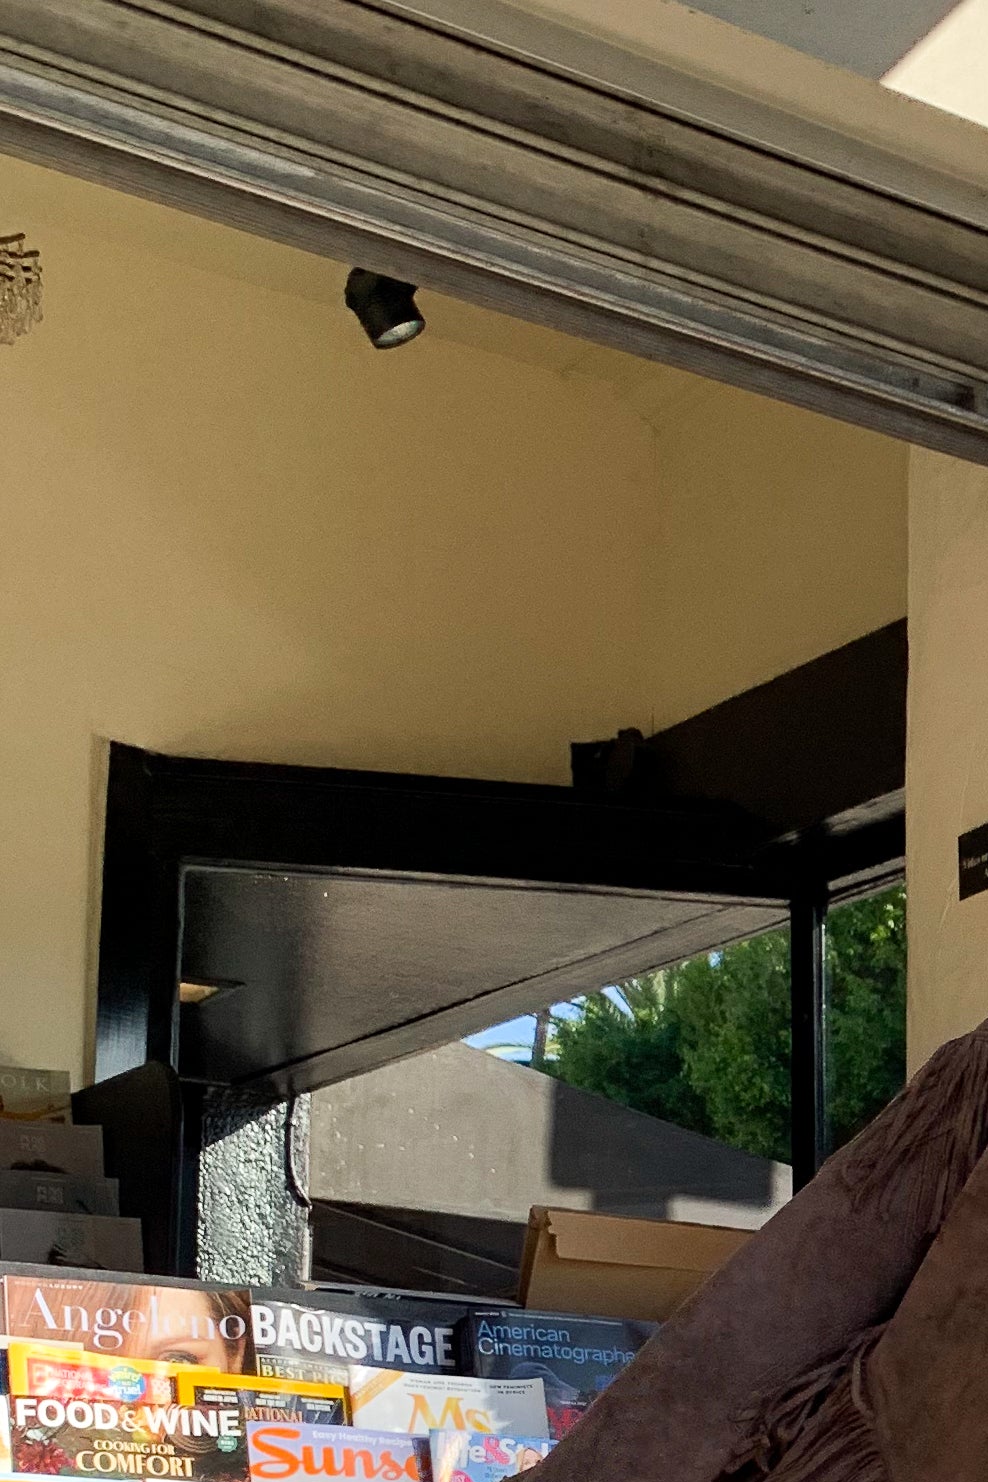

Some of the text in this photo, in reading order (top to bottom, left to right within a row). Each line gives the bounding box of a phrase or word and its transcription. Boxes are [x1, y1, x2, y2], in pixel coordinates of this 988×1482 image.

[18, 1287, 247, 1350] Angeleno
[478, 1320, 571, 1343] American
[250, 1304, 456, 1367] BACKSTAGE
[478, 1337, 637, 1366] Cinematographe
[15, 1398, 119, 1431] FOOD
[144, 1405, 242, 1438] WINE
[93, 1439, 176, 1456] COOKING FOR
[75, 1450, 195, 1478] COMFORT
